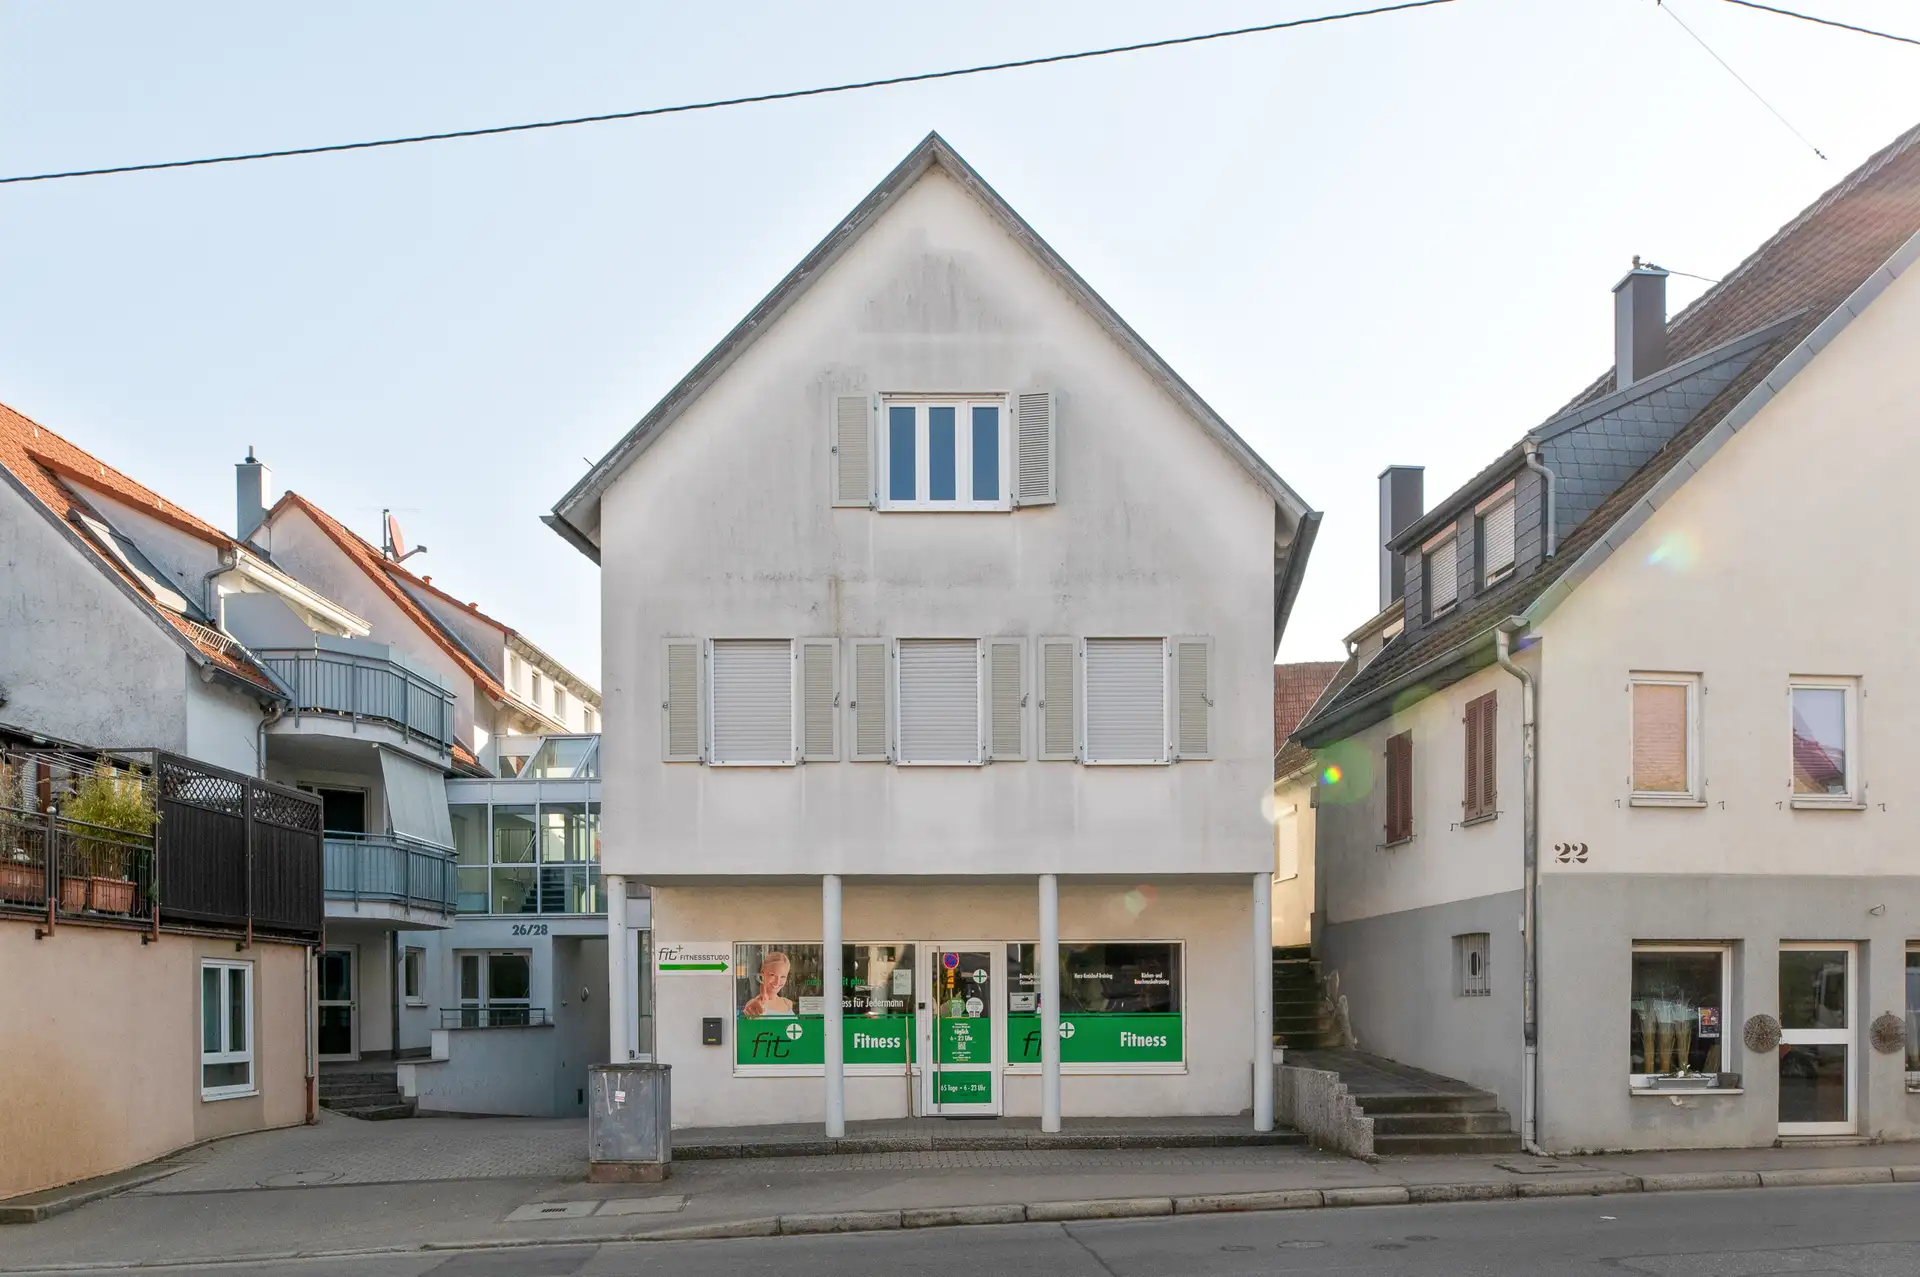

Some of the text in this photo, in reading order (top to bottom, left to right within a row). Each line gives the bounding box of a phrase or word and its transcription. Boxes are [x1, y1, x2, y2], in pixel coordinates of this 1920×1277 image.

[1554, 842, 1589, 864] 22
[512, 924, 548, 936] 26/28
[853, 996, 864, 1008] für
[865, 996, 904, 1008] Jedermann
[853, 1032, 901, 1049] Fitness
[1120, 1031, 1167, 1048] Fitness
